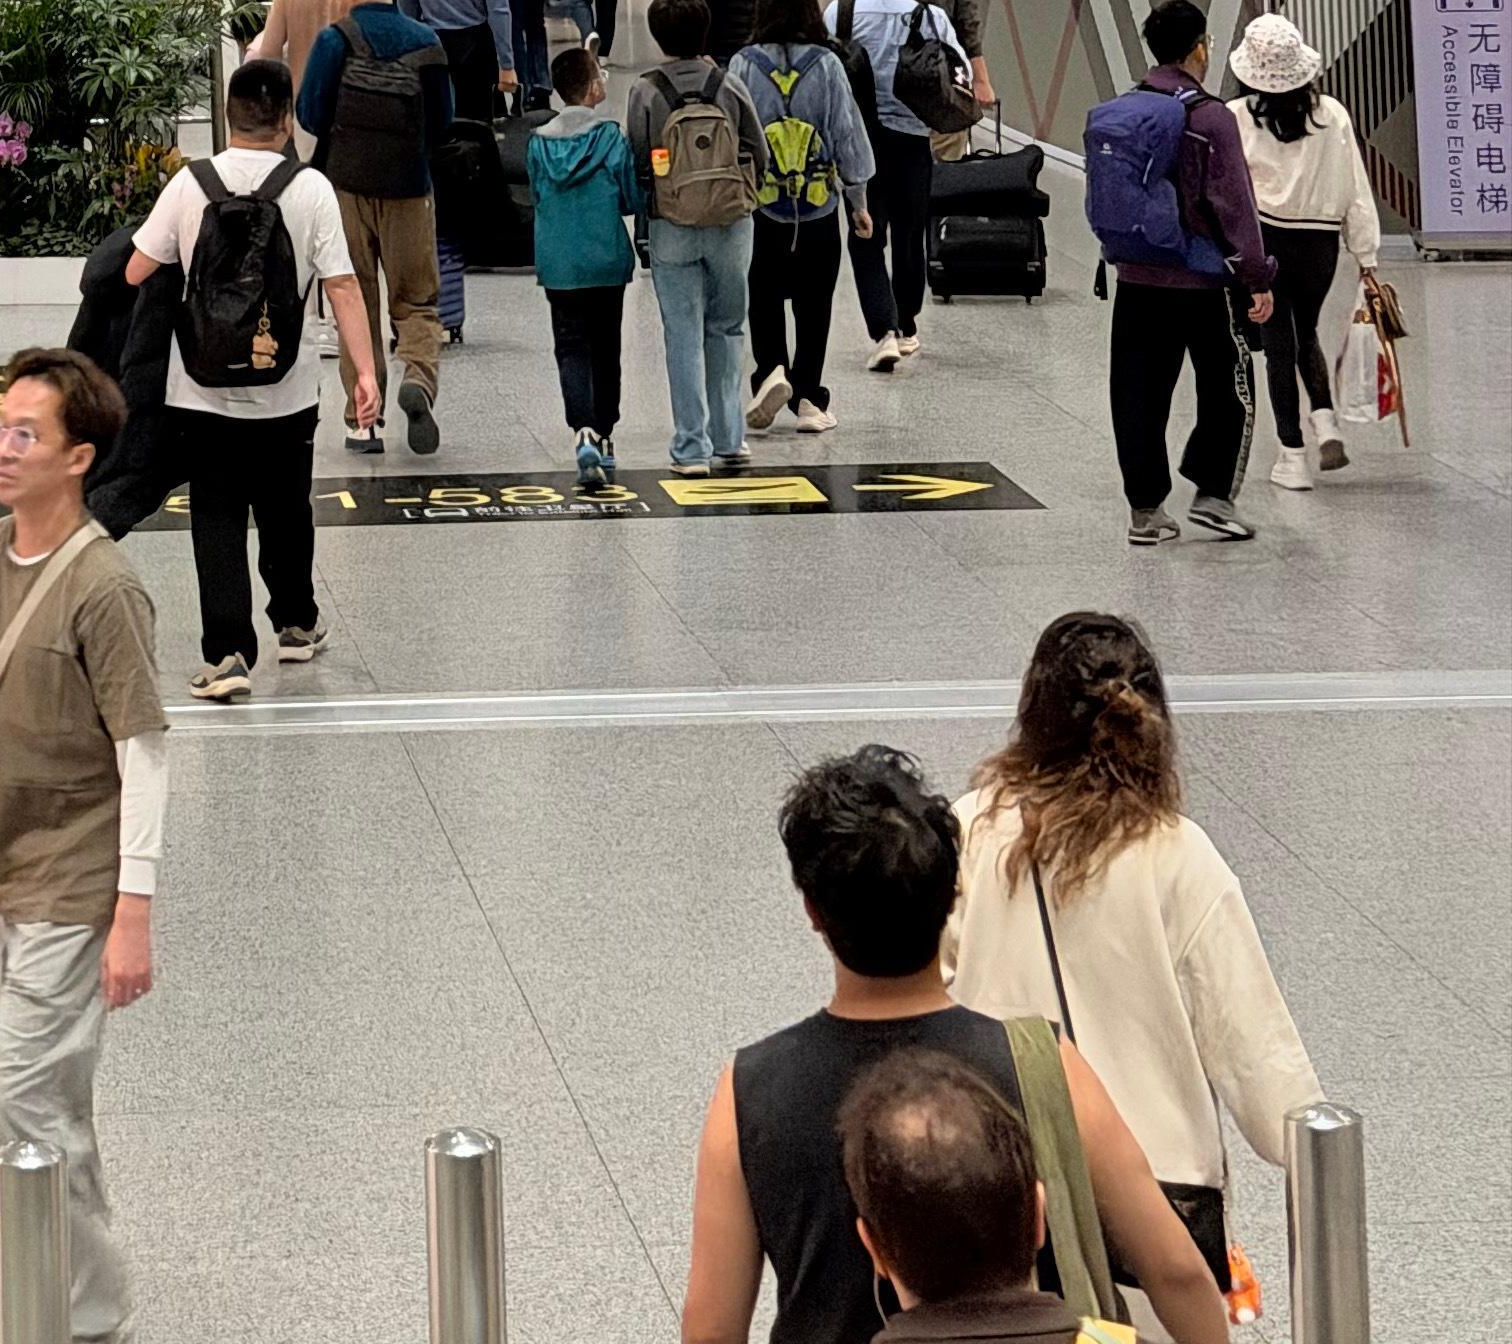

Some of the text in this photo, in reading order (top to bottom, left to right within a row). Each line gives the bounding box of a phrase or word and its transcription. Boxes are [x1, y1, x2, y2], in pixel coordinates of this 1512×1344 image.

[1441, 24, 1465, 217] Accessible Elevator
[1468, 23, 1509, 214] 无障碍电梯
